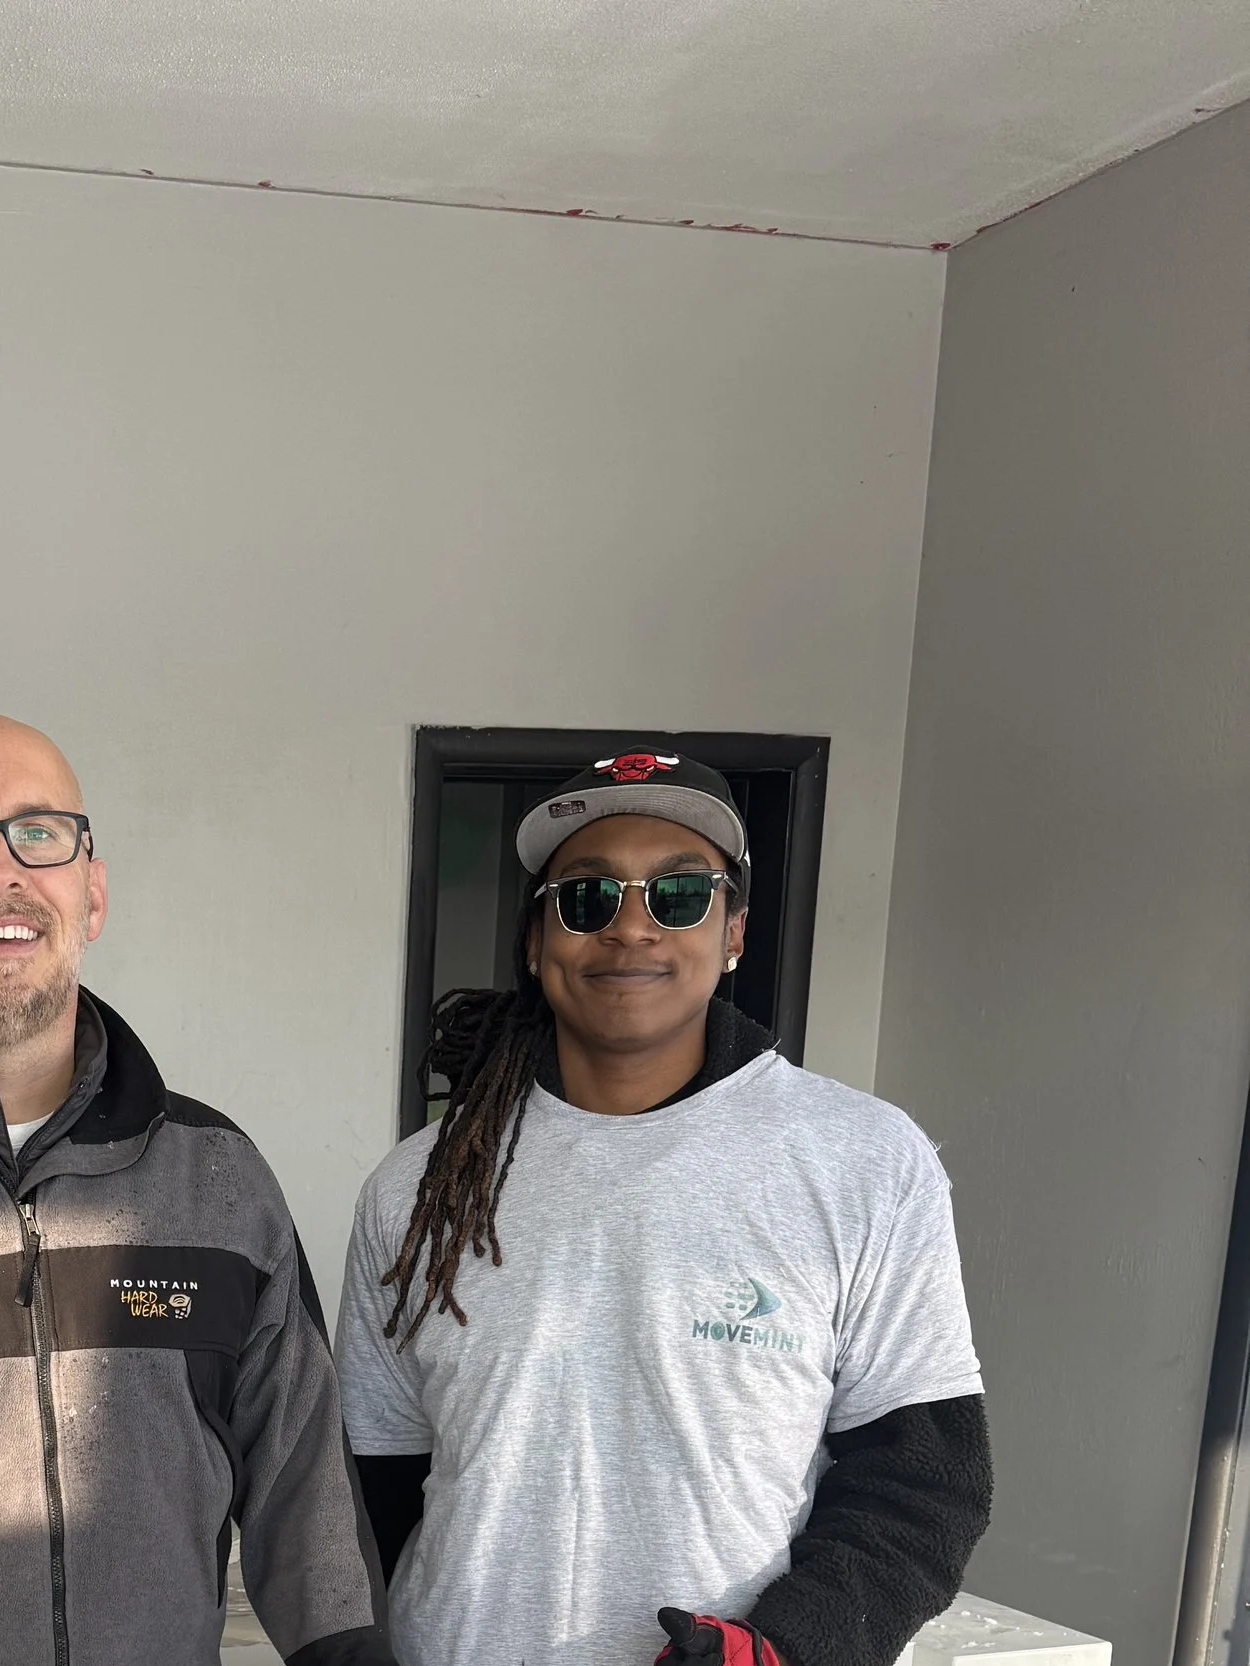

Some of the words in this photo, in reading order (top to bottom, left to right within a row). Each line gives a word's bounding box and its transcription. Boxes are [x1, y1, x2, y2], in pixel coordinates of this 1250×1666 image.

[110, 1278, 198, 1290] MOUNTAIN
[121, 1290, 158, 1304] HARD
[131, 1303, 169, 1318] WEAR
[692, 1319, 806, 1353] MOVEMINT
